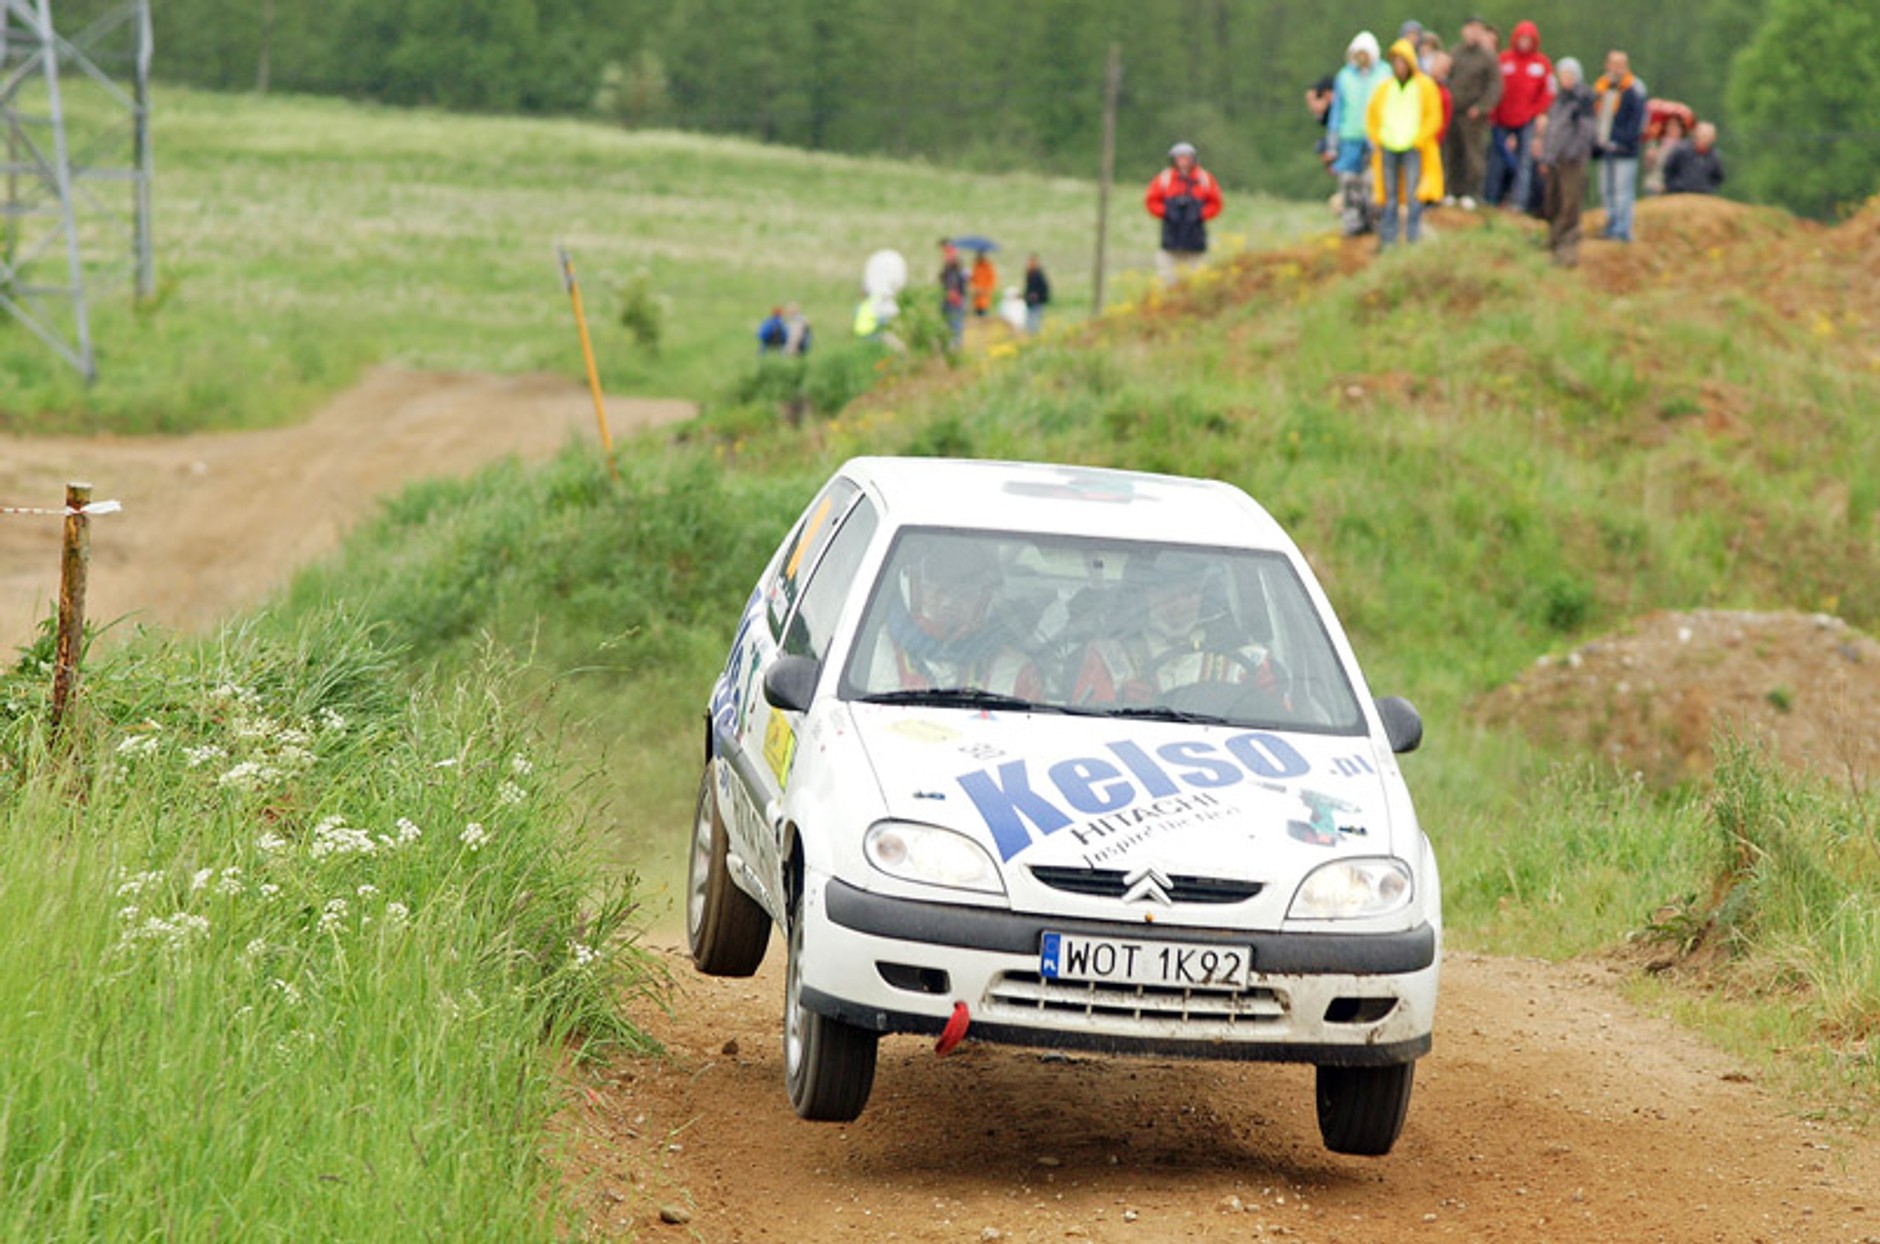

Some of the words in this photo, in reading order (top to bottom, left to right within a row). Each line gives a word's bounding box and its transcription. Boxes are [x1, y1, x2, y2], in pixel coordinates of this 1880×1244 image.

[956, 733, 1311, 863] Kelso
[1070, 793, 1218, 845] HITACHI
[1066, 941, 1142, 978] WOT
[1159, 947, 1242, 986] 1K92
